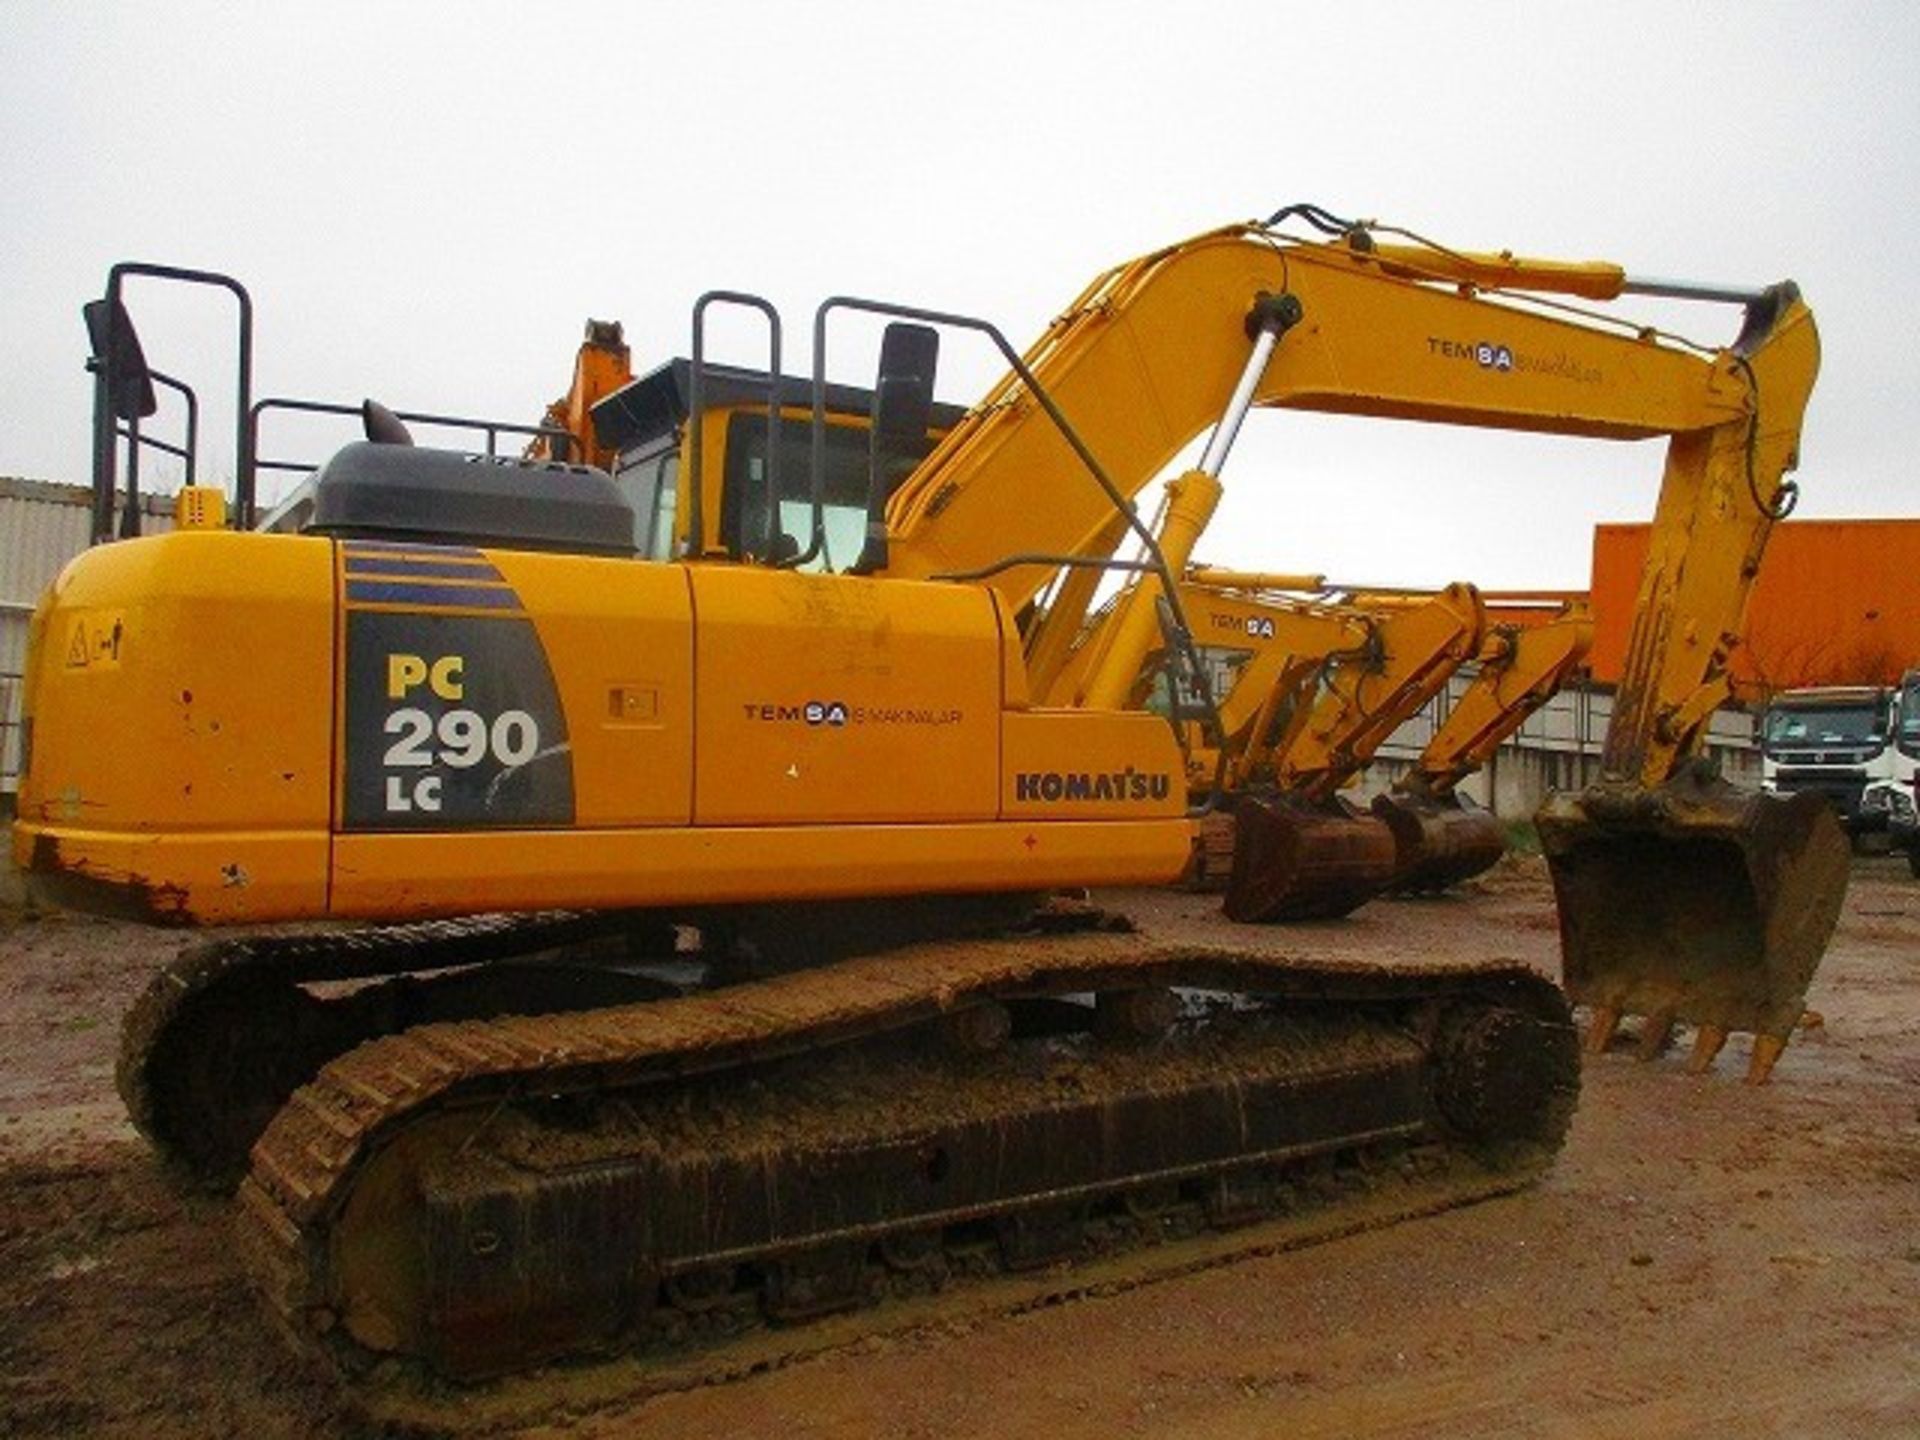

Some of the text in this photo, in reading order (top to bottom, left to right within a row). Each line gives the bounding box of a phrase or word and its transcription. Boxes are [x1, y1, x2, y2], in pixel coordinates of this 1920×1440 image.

[1427, 336, 1513, 372] TEMSA
[388, 653, 464, 700] PC
[743, 701, 848, 726] TEMSA
[383, 707, 539, 769] 290
[386, 775, 442, 811] LC
[1016, 766, 1170, 801] KOMATSU
